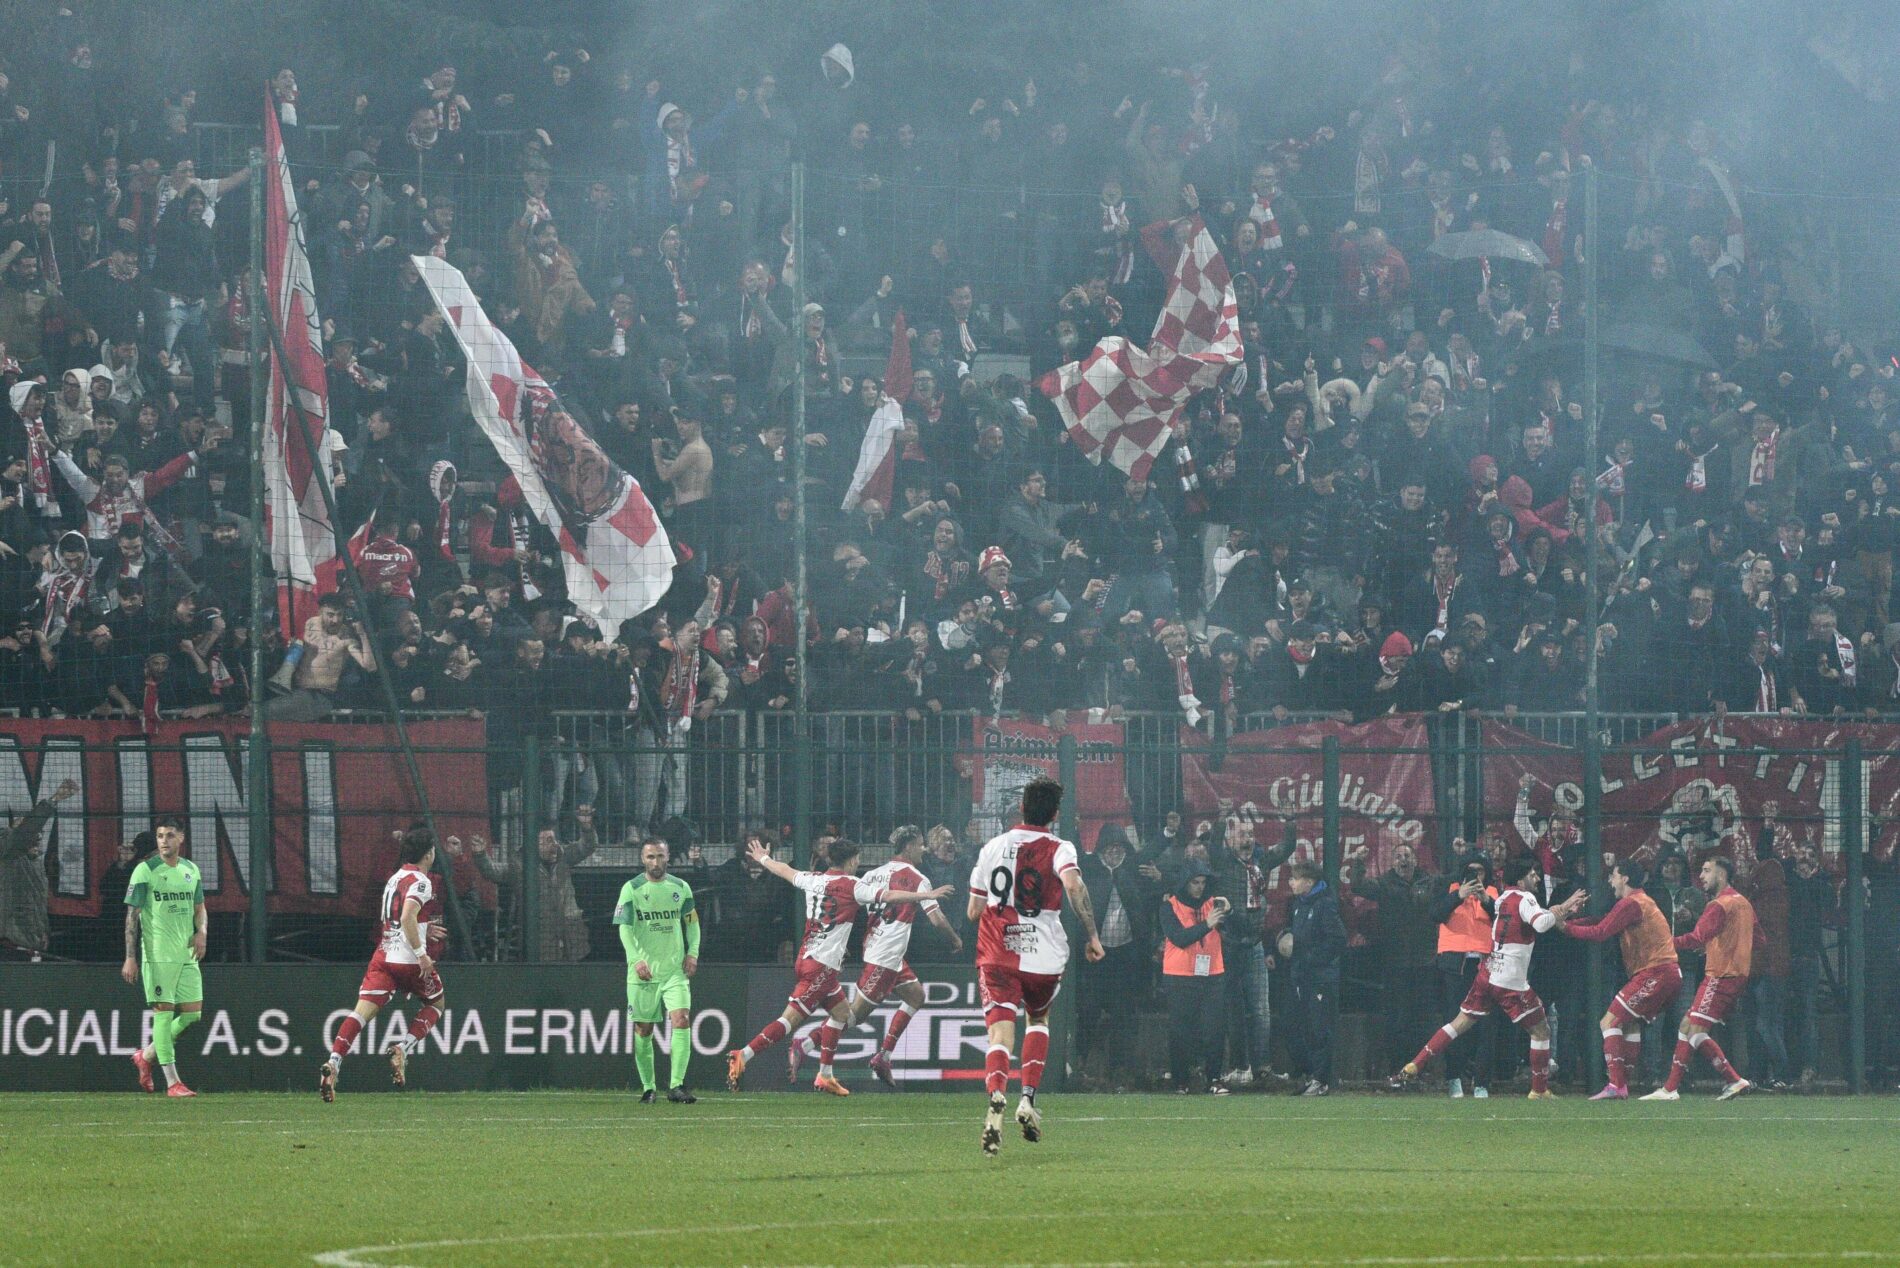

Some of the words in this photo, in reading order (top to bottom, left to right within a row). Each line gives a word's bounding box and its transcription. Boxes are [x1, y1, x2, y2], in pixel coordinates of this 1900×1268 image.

[364, 552, 408, 562] macron
[1269, 774, 1425, 842] Giuliano
[202, 1008, 302, 1056] A.S.
